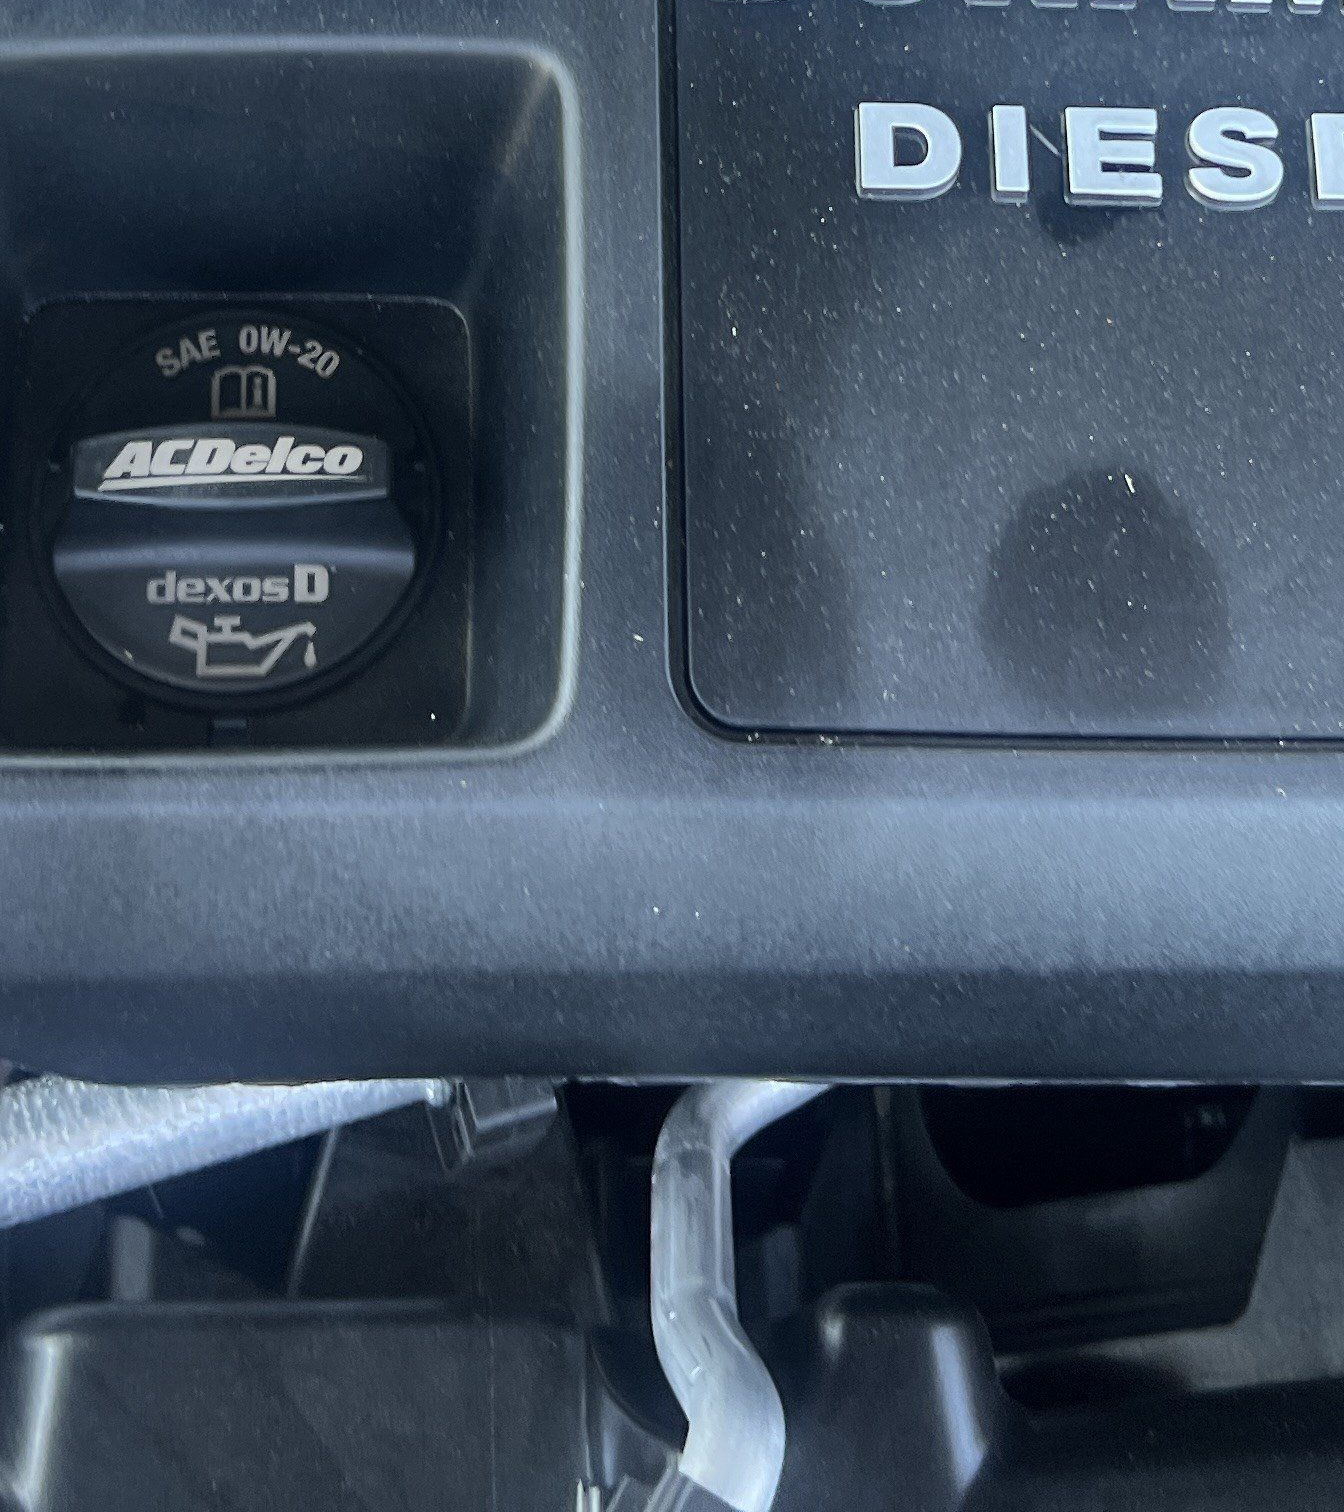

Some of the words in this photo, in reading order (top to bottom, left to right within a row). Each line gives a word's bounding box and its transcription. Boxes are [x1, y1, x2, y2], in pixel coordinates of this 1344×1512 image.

[156, 329, 221, 378] SAE
[238, 324, 341, 380] 0W-20
[102, 436, 364, 479] ACDelco
[146, 563, 330, 605] dexosD
